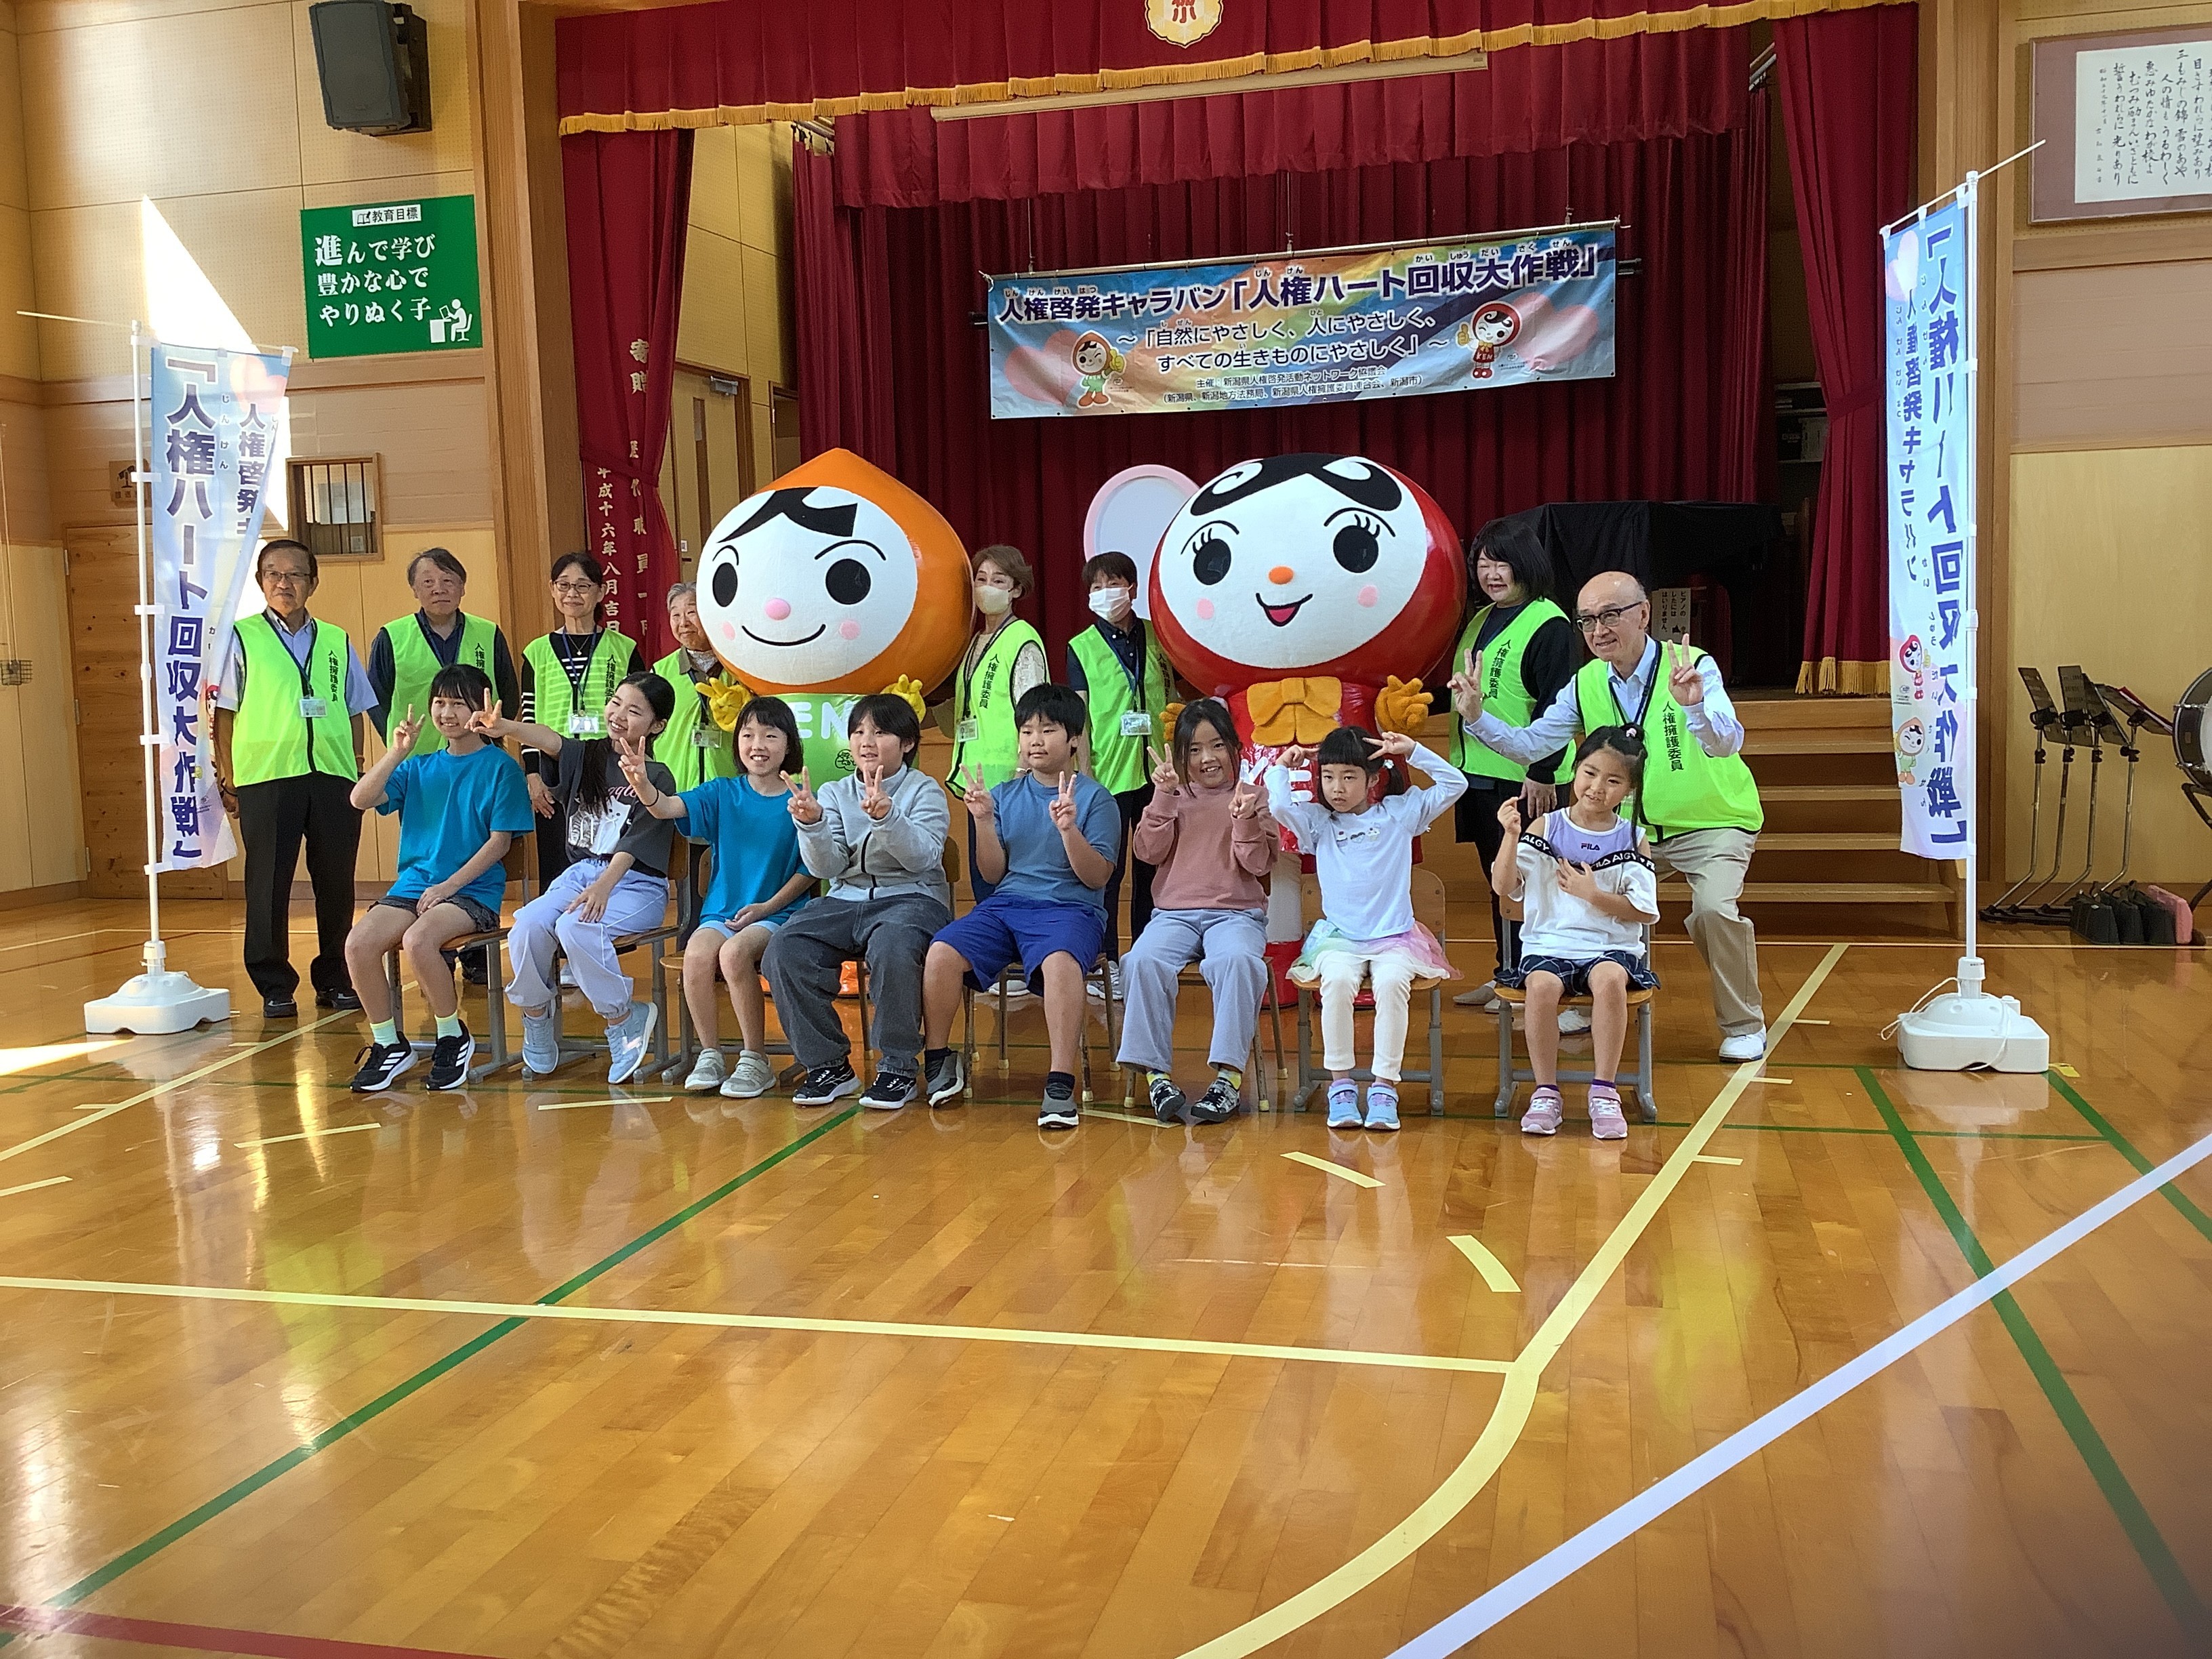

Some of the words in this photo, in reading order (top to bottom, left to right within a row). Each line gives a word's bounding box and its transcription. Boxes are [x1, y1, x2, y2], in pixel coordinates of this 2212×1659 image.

[372, 207, 419, 224] 教育目標
[314, 233, 436, 267] 進んで学び
[1415, 255, 1433, 263] かい
[1450, 251, 1469, 260] しゅう
[1481, 249, 1499, 257] だい
[1519, 245, 1536, 253] さく
[1552, 239, 1570, 248] せん
[317, 266, 428, 297] 豊かな心で
[319, 296, 432, 328] やりぬく子
[979, 654, 1000, 710] 人権擁護委員
[1489, 640, 1511, 699] 人権擁護委員
[1662, 701, 1684, 772] 人権擁護委員
[1521, 834, 1549, 851] ALGY
